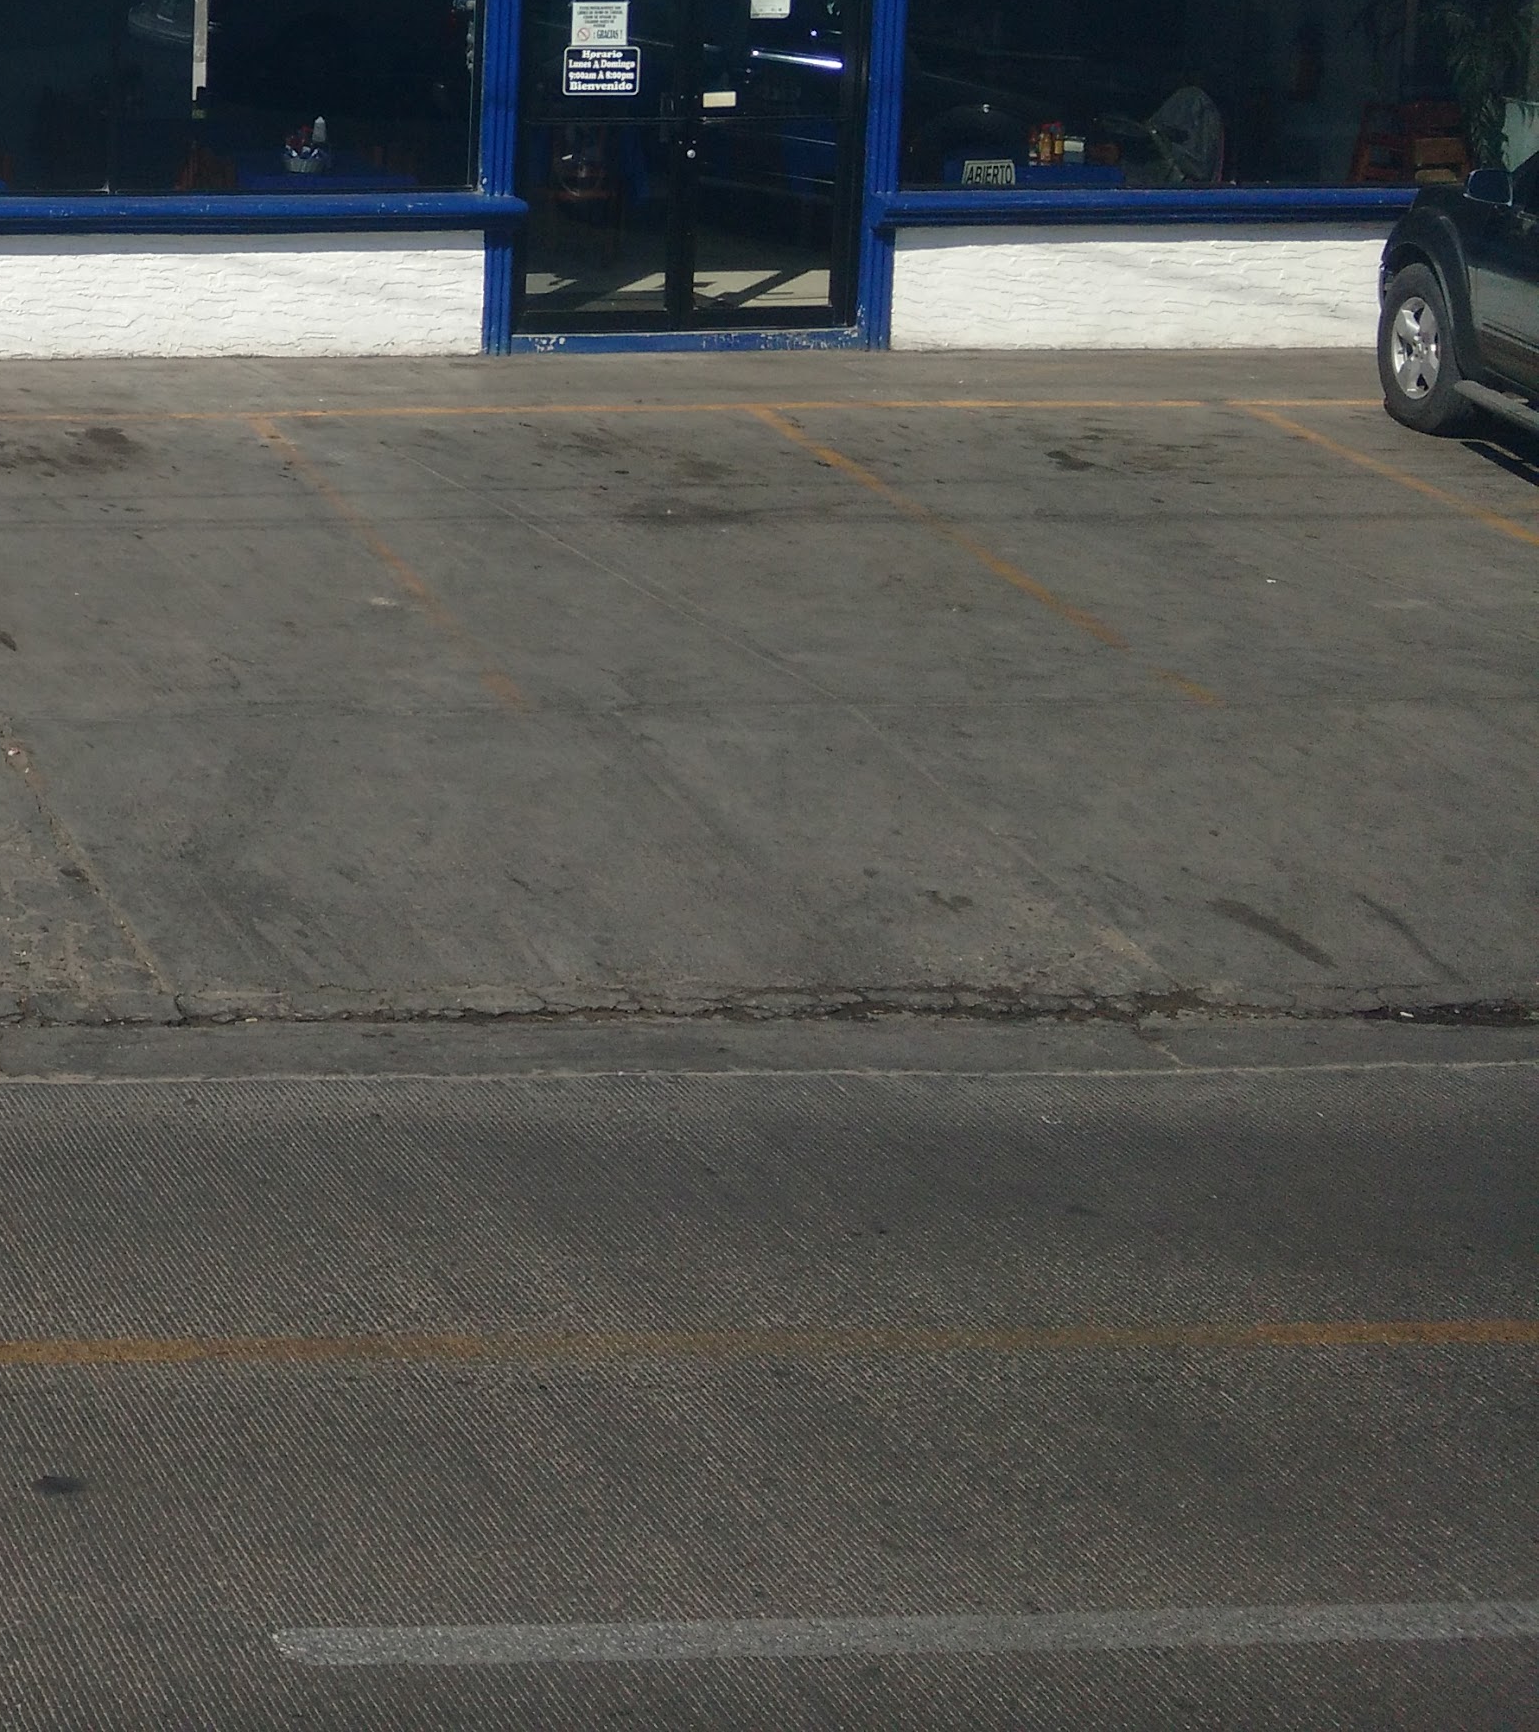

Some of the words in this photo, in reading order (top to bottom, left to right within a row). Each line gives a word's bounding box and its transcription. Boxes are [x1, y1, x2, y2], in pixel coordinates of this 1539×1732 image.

[581, 50, 623, 60] Horario
[568, 59, 592, 69] Lunes
[592, 60, 600, 69] A
[601, 59, 636, 70] Domingo
[597, 70, 605, 79] A
[569, 81, 634, 91] Bienvenido
[966, 164, 1013, 184] ABIERTO
